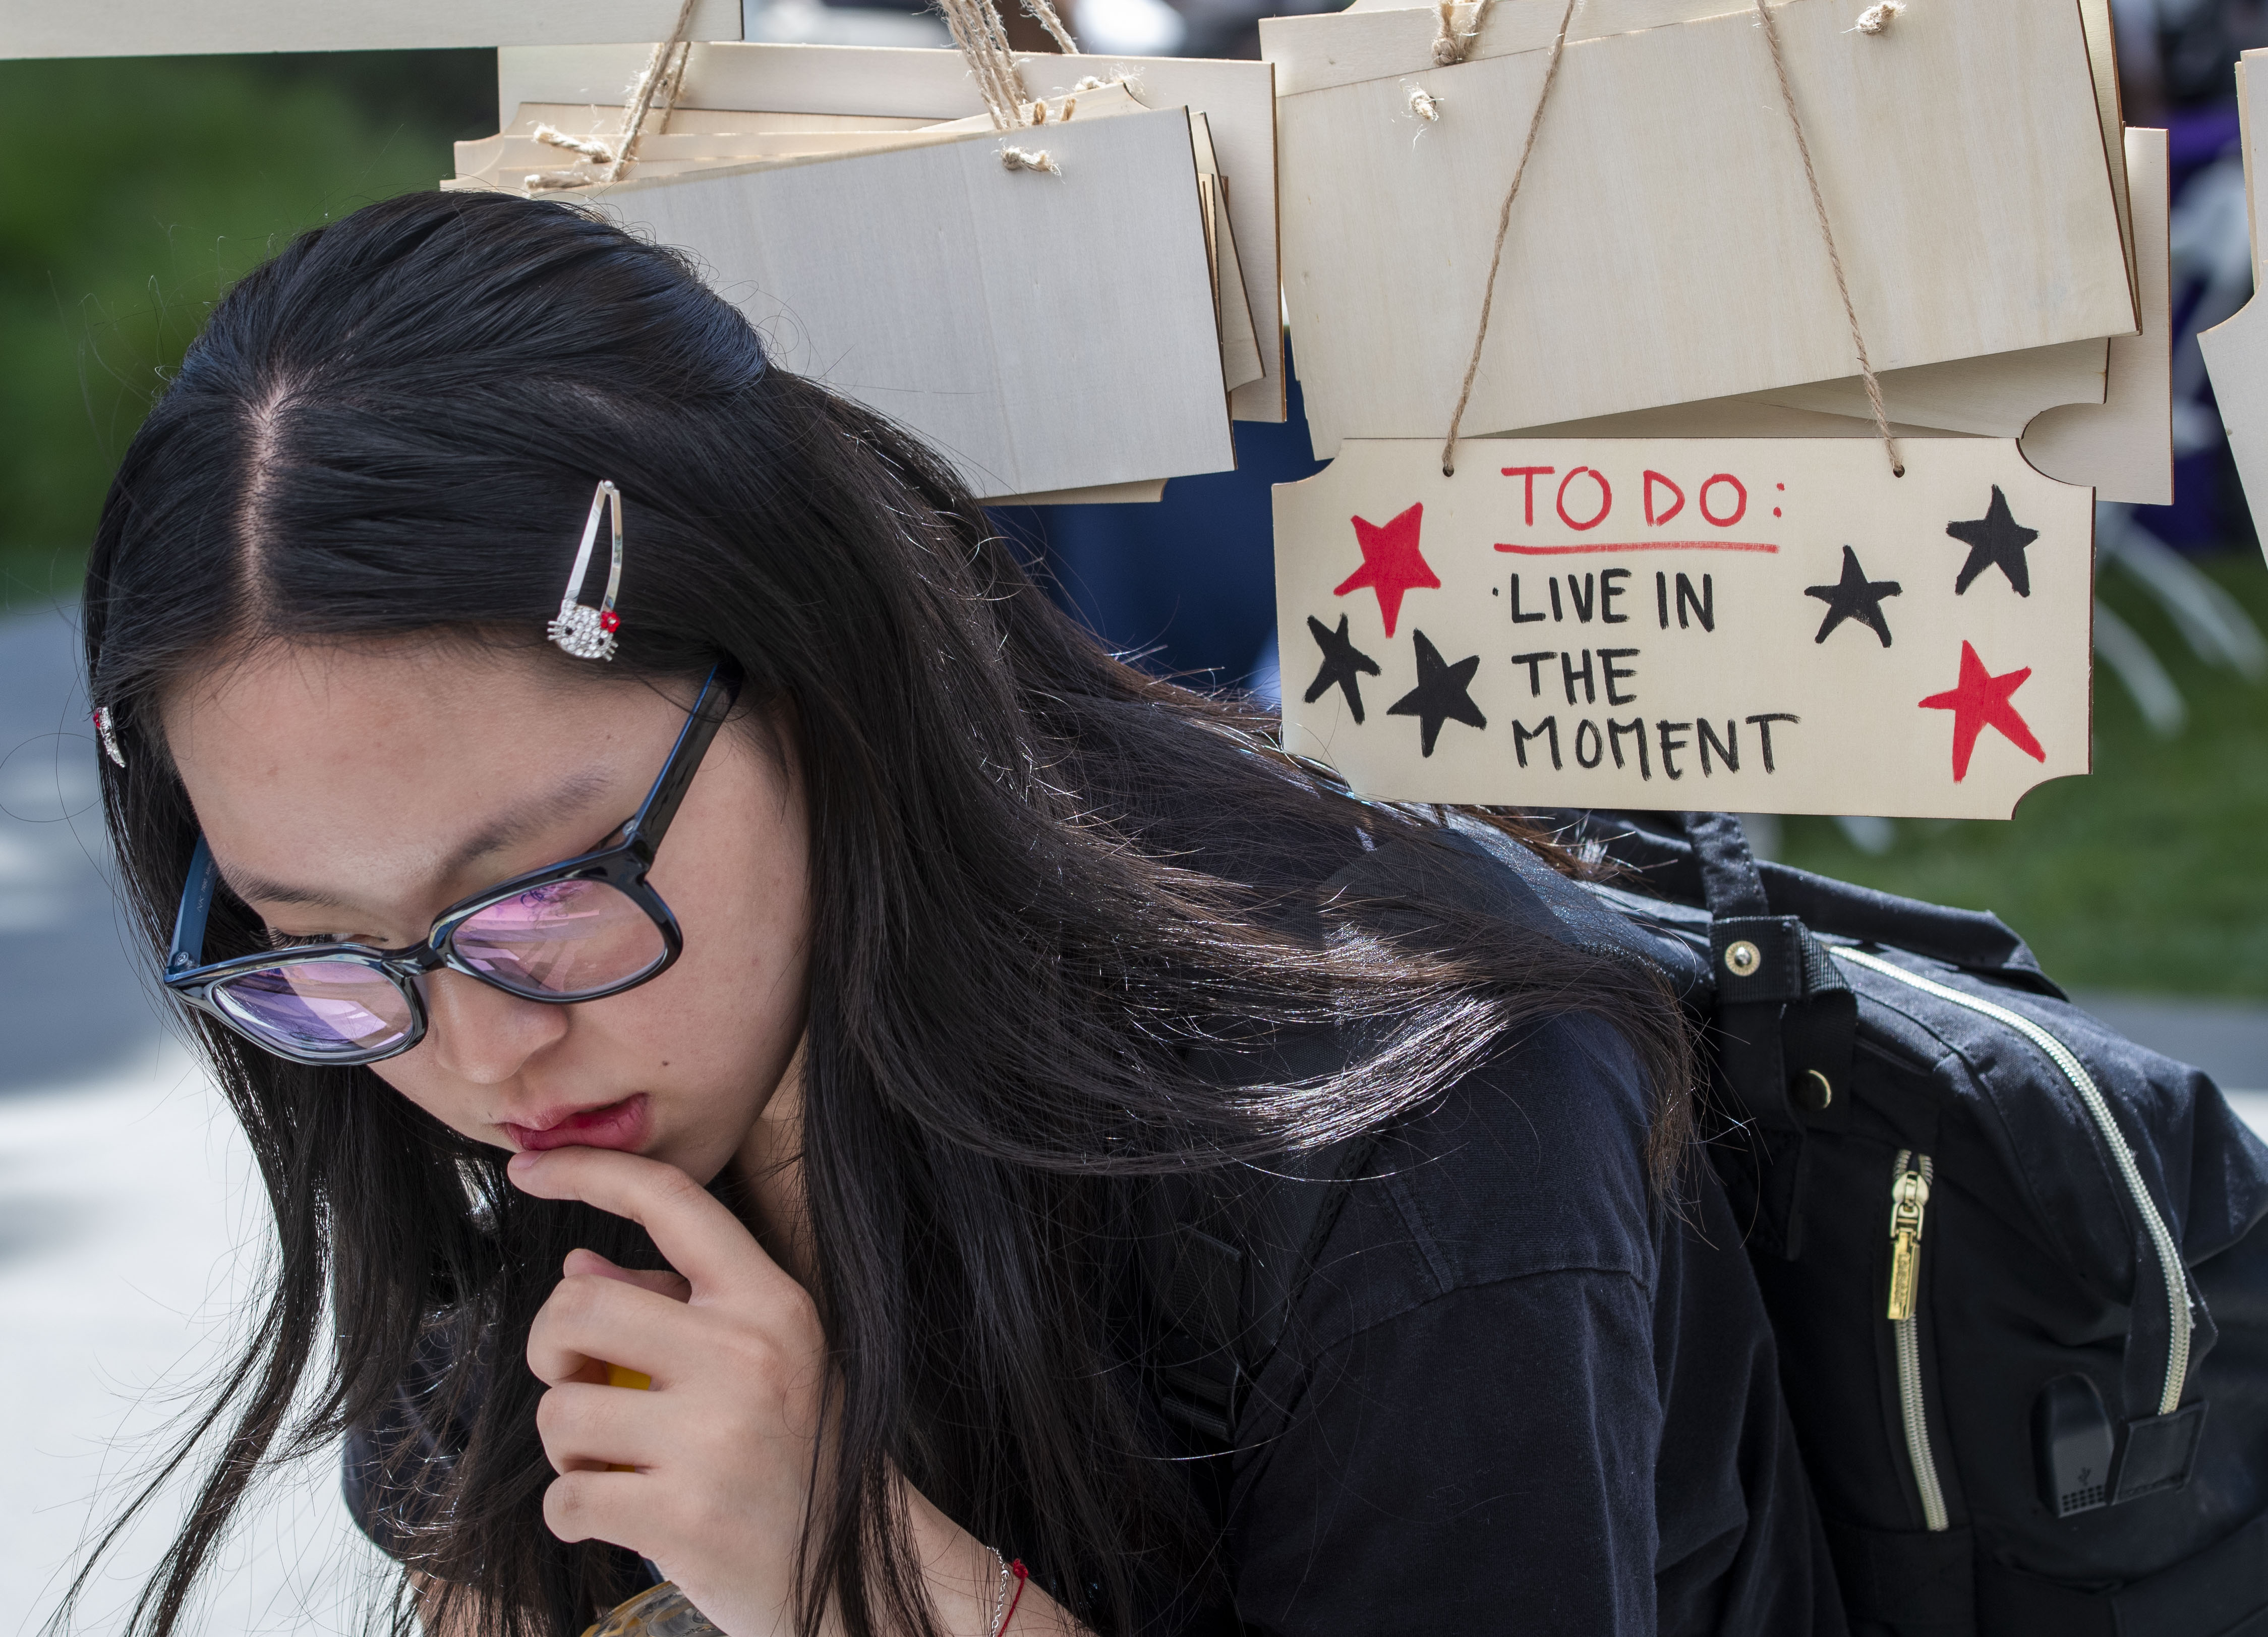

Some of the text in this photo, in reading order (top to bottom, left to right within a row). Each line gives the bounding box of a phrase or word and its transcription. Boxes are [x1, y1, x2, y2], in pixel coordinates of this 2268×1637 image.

[1500, 466, 1785, 531] TO DO:
[1656, 571, 1715, 633] IN
[1511, 649, 1640, 707] THE
[1511, 712, 1799, 782] MOMENT
